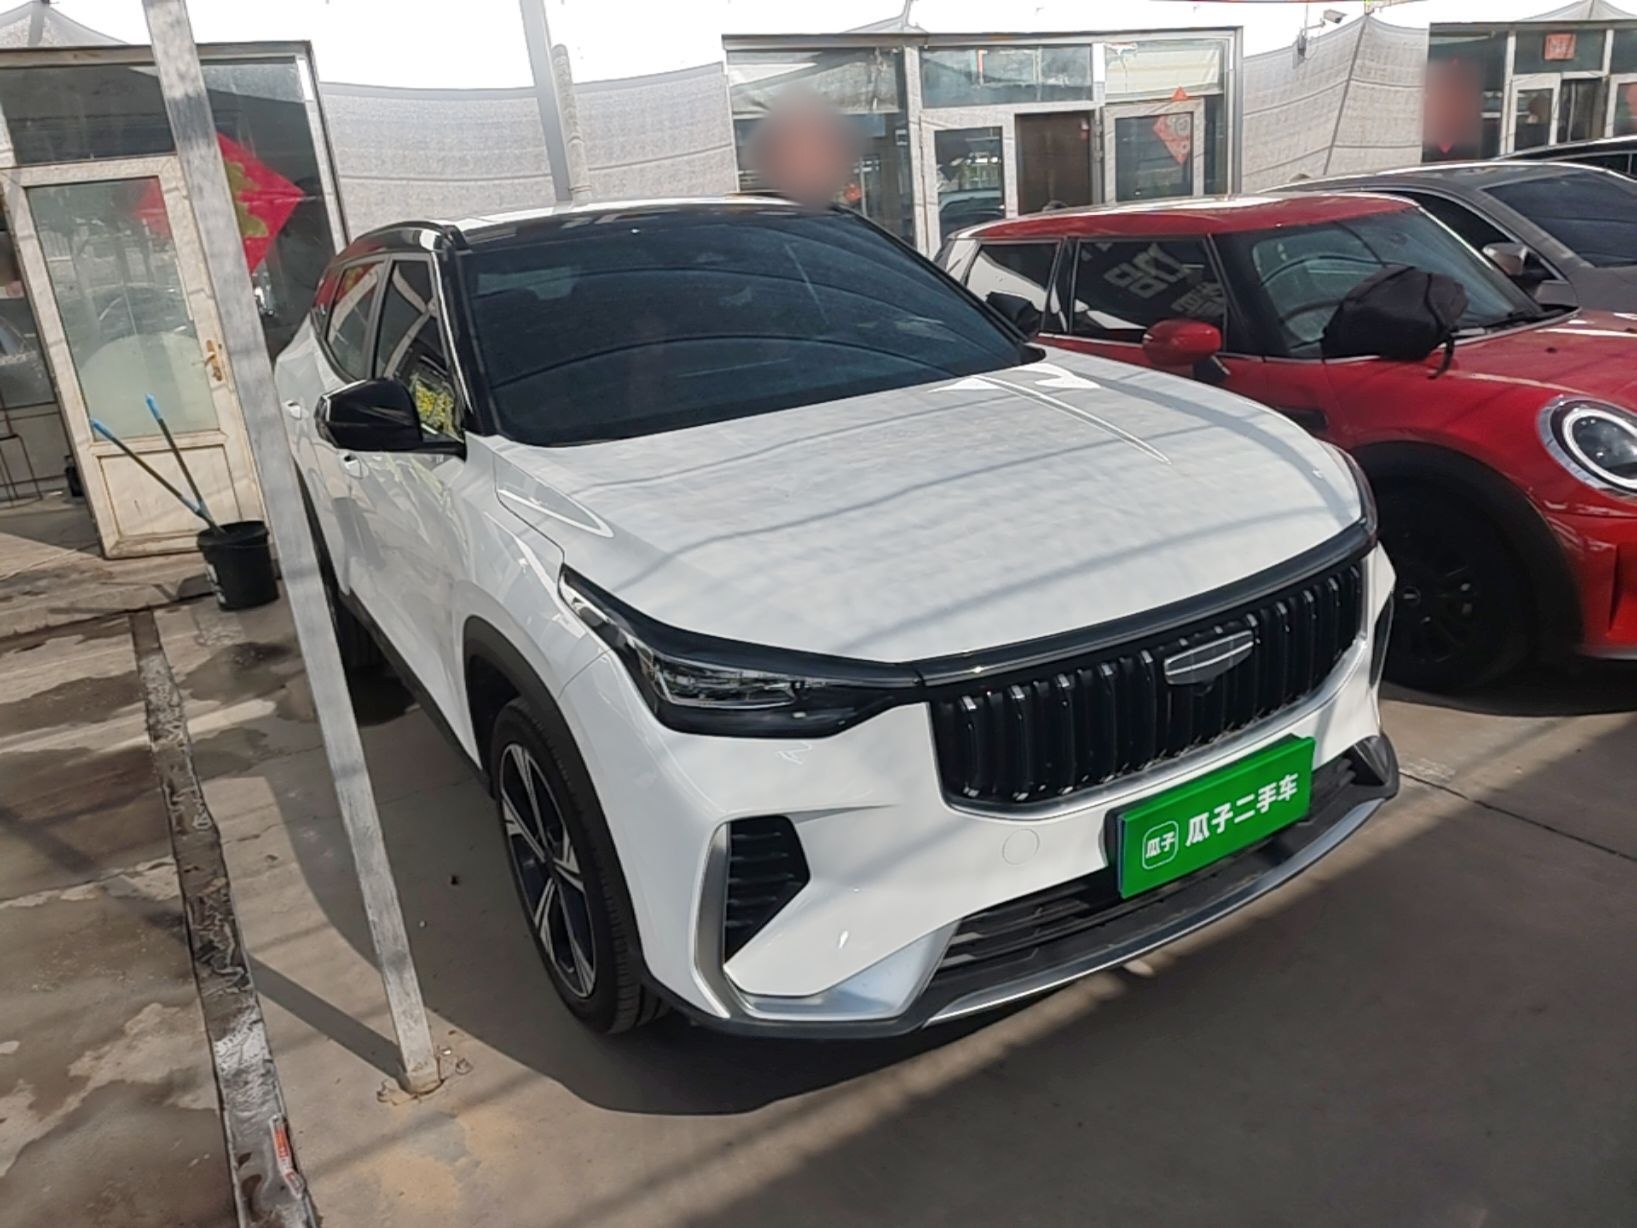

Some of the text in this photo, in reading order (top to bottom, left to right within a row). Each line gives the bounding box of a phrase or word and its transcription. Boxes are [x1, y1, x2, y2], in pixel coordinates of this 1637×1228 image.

[1185, 773, 1298, 847] 瓜子二手车
[1145, 831, 1176, 859] 瓜子
